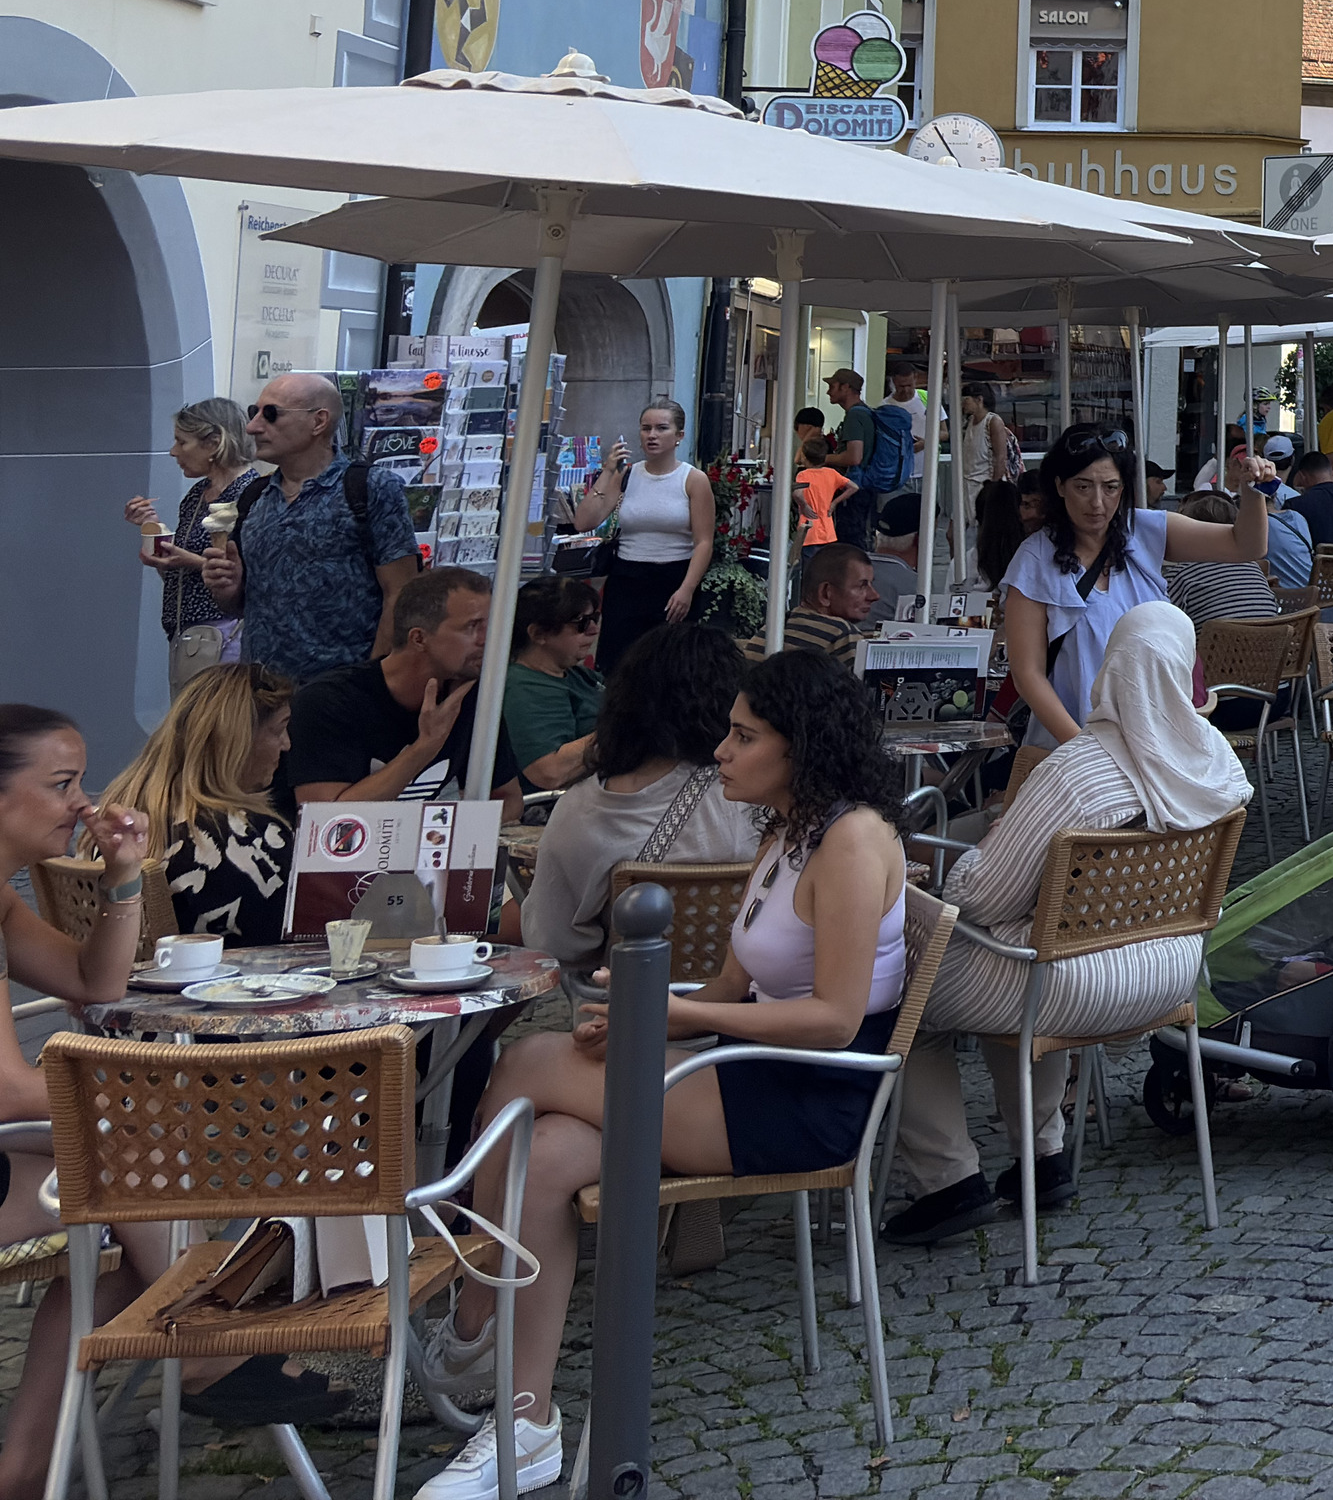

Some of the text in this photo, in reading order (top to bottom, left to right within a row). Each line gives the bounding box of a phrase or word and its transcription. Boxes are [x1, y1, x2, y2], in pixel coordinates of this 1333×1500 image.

[1039, 9, 1089, 24] SALON
[805, 103, 894, 116] EISCAFE
[773, 102, 893, 137] DOLOMITI
[387, 895, 404, 906] 55
